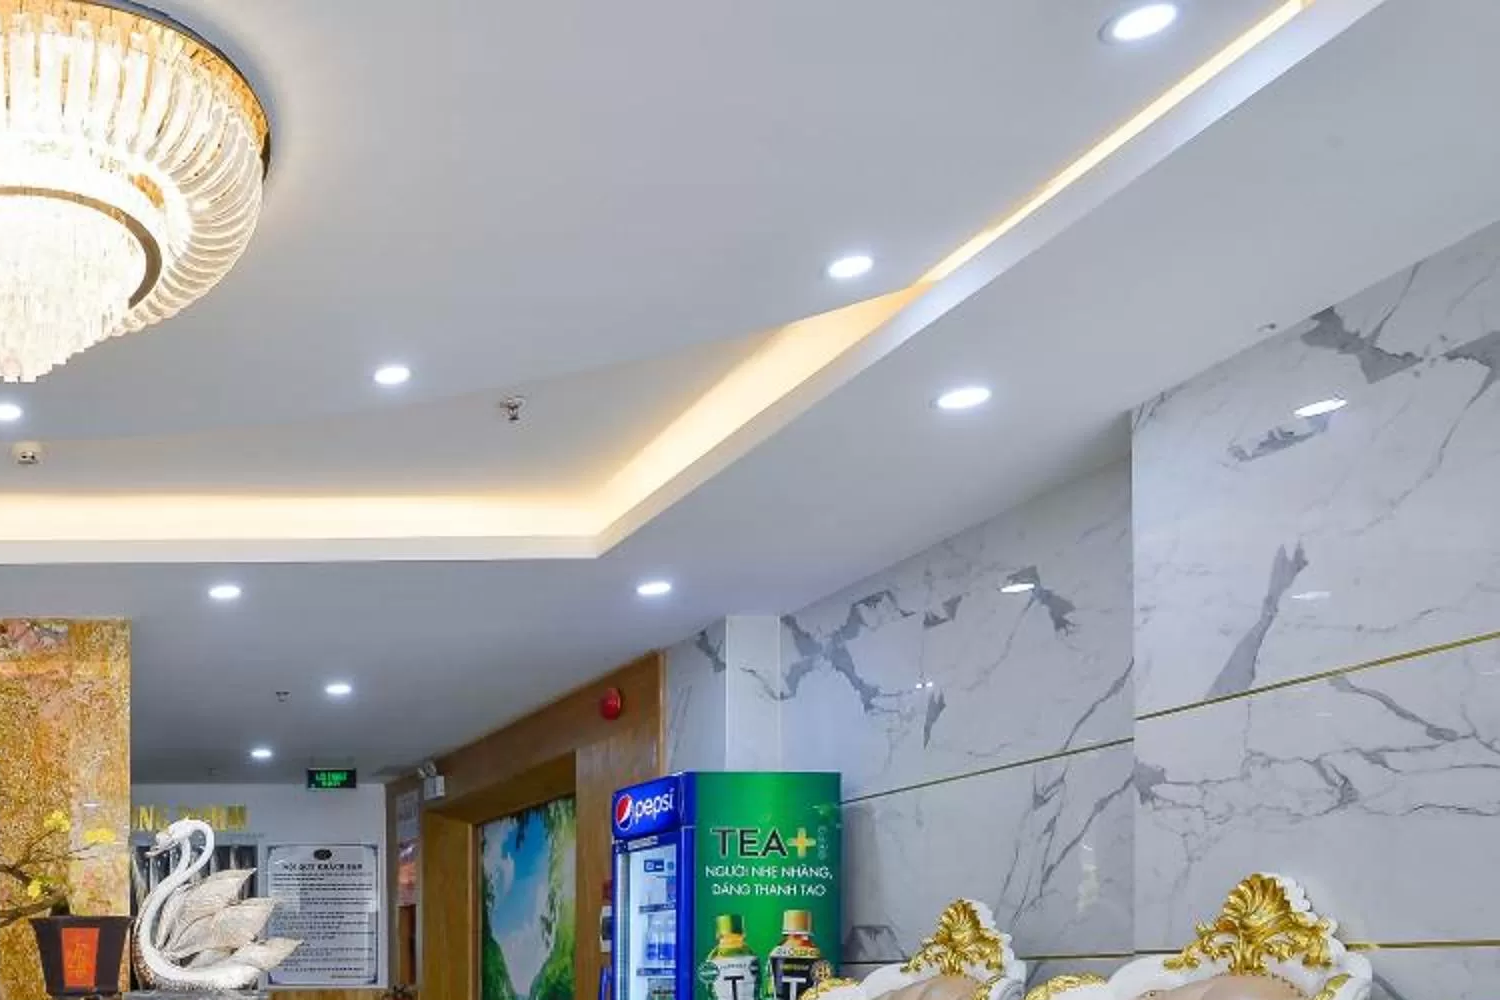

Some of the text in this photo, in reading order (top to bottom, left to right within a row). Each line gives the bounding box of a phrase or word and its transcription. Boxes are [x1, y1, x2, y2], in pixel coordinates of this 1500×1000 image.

[635, 787, 676, 825] pepsi
[710, 826, 817, 860] TEA+
[754, 883, 797, 897] THANH
